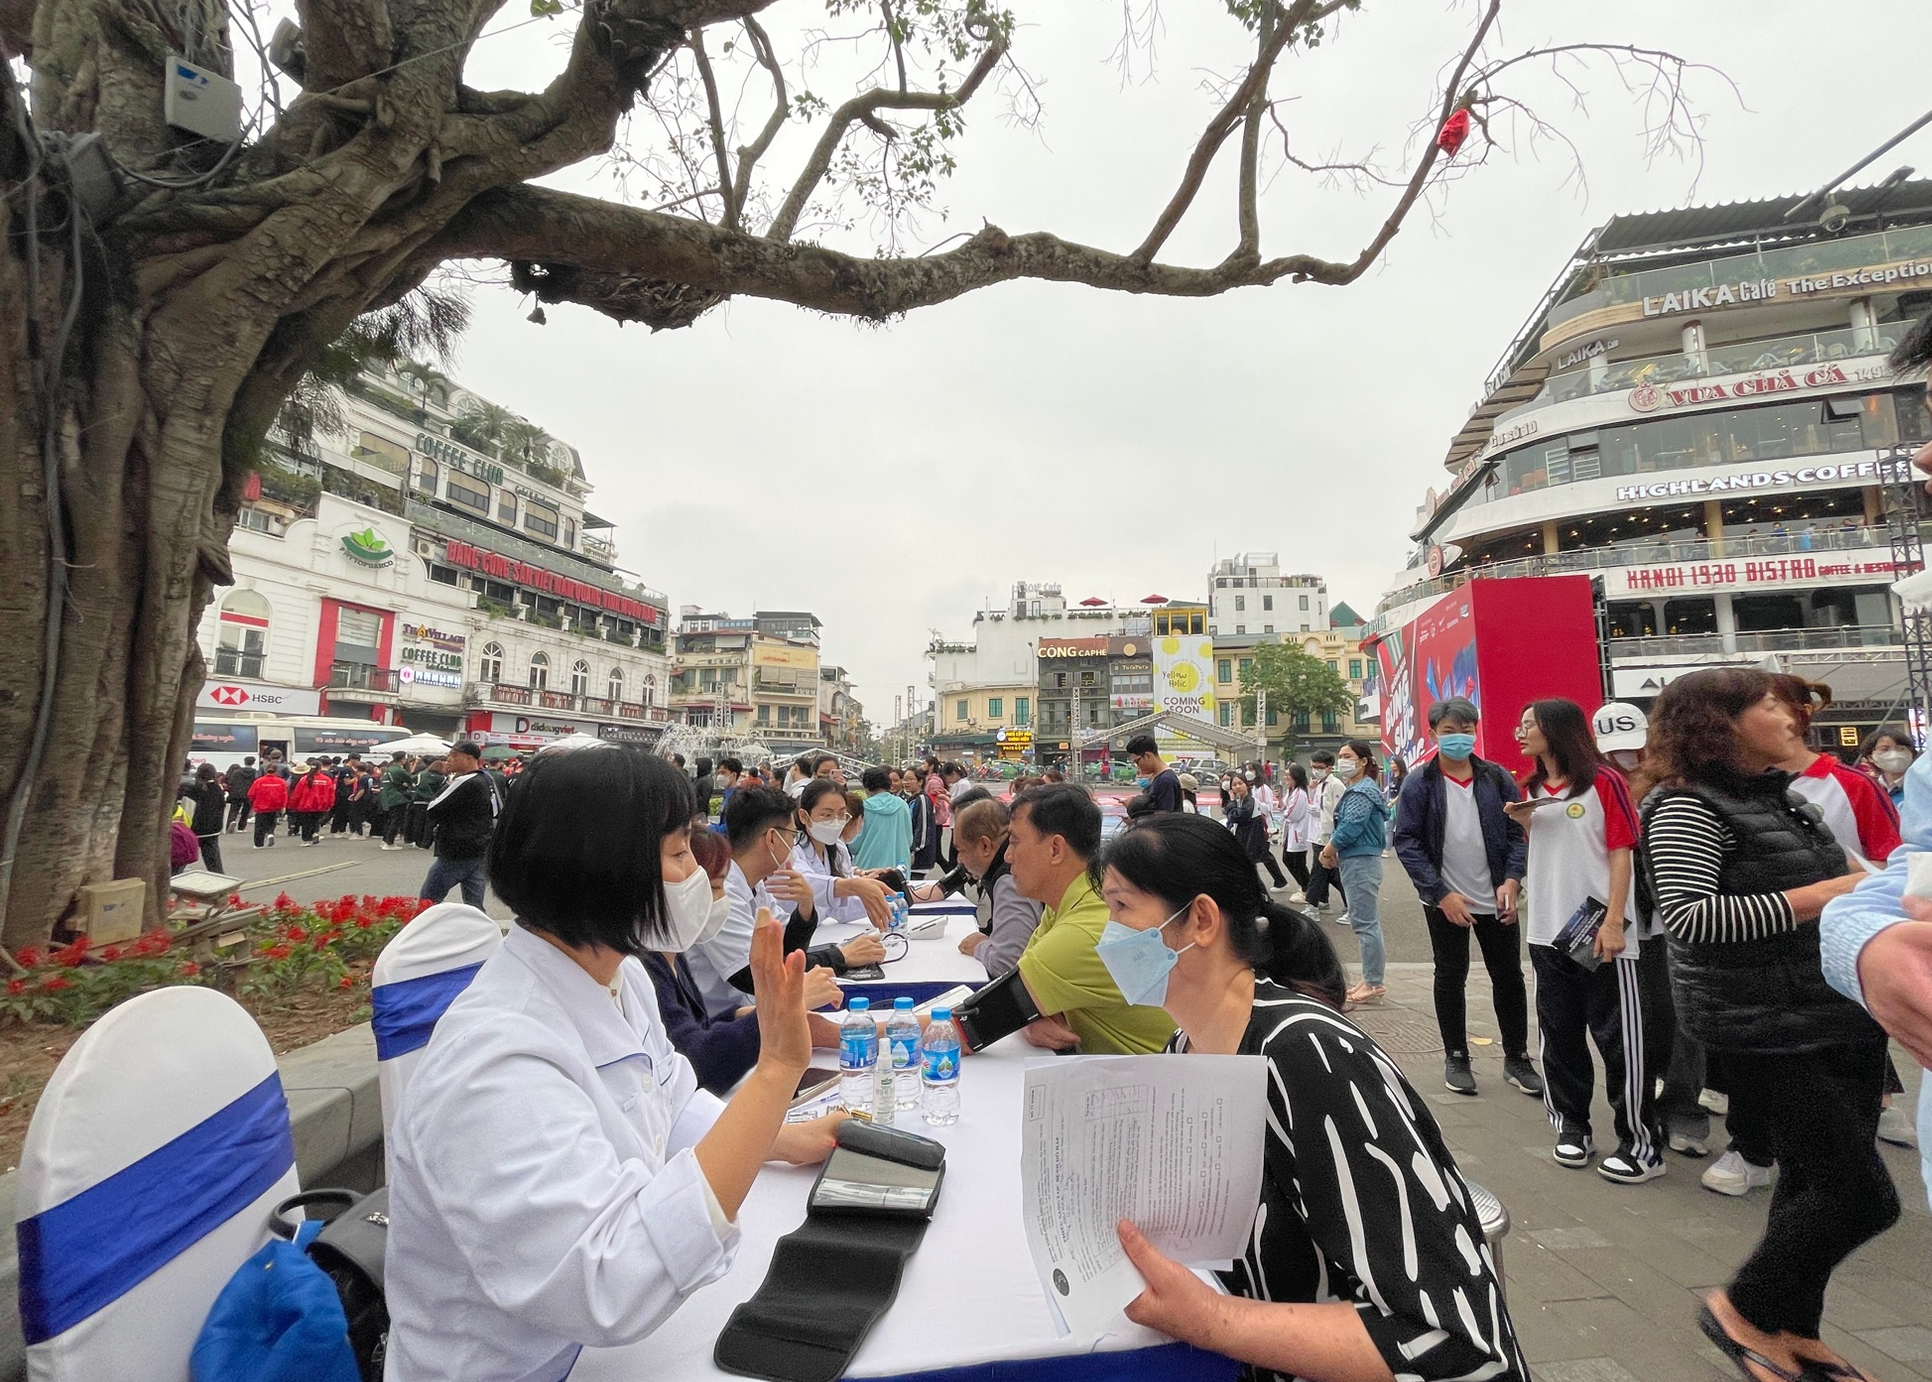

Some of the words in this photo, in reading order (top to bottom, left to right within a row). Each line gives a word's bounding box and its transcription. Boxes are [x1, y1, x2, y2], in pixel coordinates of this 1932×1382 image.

[1642, 284, 1735, 317] LAIKA
[1738, 278, 1776, 302] Café
[1786, 278, 1827, 295] The
[1831, 262, 1932, 288] Exceptio
[1557, 340, 1605, 370] LAIKA
[1666, 384, 1730, 406] VUA
[1733, 369, 1799, 398] CHẢ
[1804, 364, 1849, 388] CÁ
[416, 433, 467, 471] COFFEE
[473, 458, 504, 486] CLUB
[1616, 470, 1790, 501] HIGHLANDS
[1627, 565, 1685, 590] HANOI
[1691, 564, 1736, 586] 1930
[1745, 558, 1816, 583] BISTRO
[402, 647, 437, 663] COFFEE
[440, 653, 462, 667] CLUB
[1162, 670, 1187, 679] Yellow
[252, 694, 283, 704] HSBC
[1163, 697, 1206, 705] COMING
[1169, 705, 1200, 714] SOON
[1597, 715, 1636, 735] US
